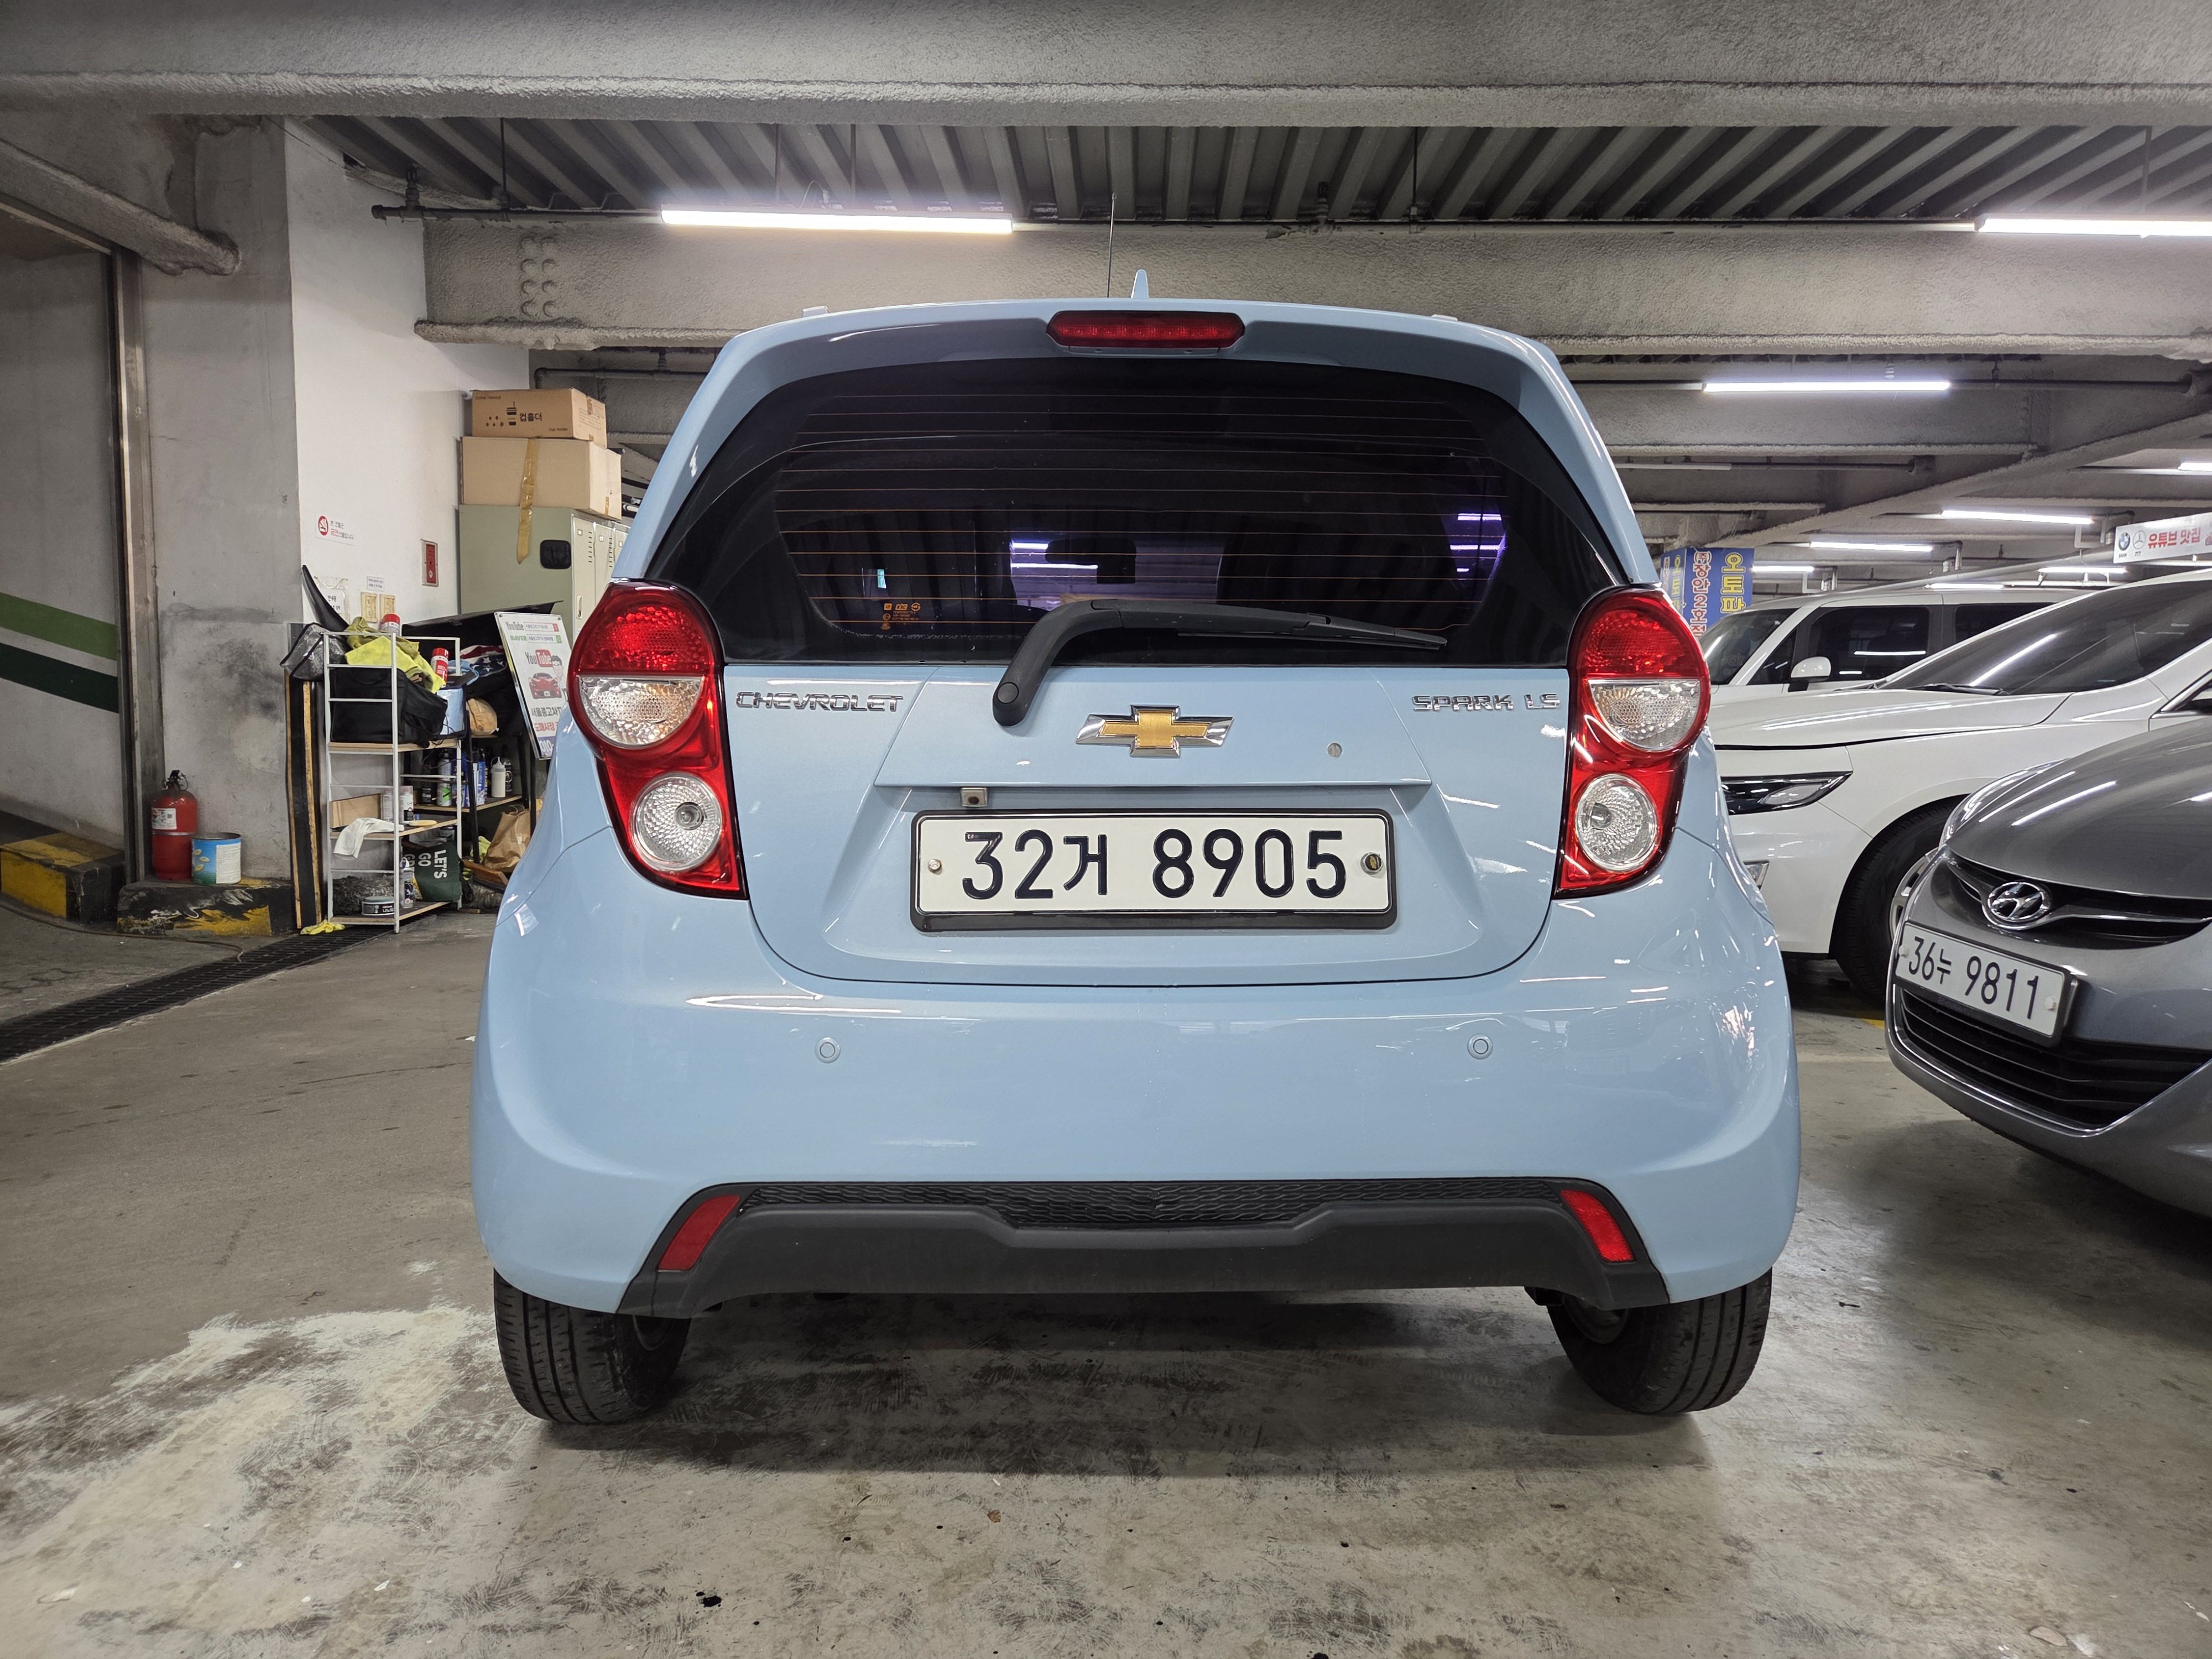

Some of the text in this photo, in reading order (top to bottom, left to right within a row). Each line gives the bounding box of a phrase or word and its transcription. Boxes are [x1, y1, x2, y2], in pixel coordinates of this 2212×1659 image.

[519, 413, 542, 422] 컵홀더
[2148, 526, 2201, 549] 유튜브 맛집
[525, 651, 552, 666] YouTube
[736, 691, 904, 712] CHEVROLET
[1412, 693, 1561, 711] SPARK LS
[418, 853, 431, 867] GO
[434, 849, 447, 879] LET'S
[962, 828, 1347, 900] 32거 8905
[1908, 936, 2039, 1020] 36누 9811
